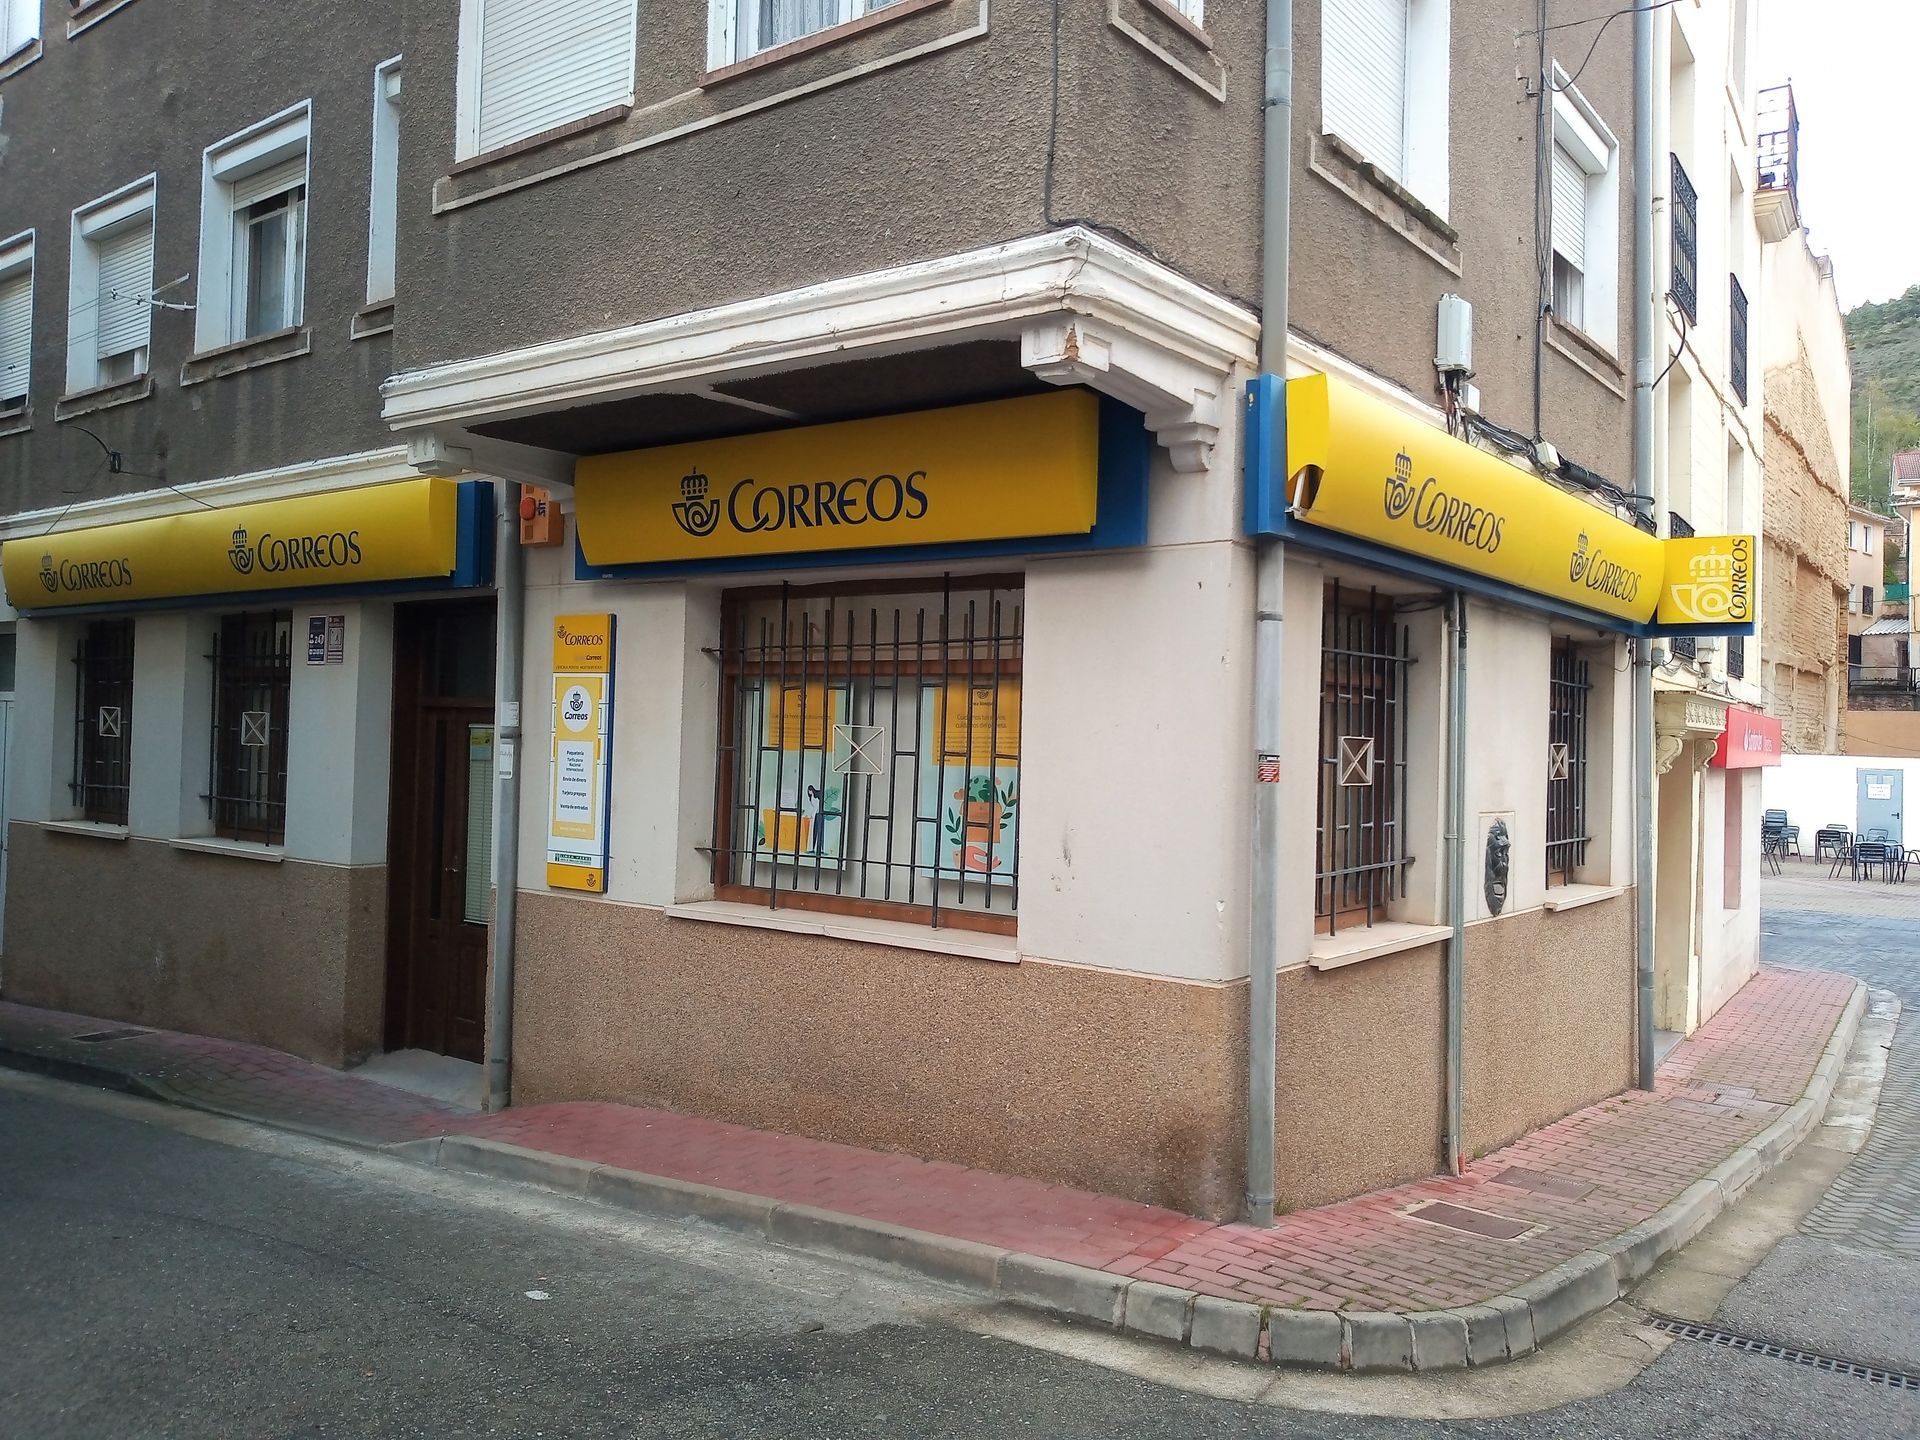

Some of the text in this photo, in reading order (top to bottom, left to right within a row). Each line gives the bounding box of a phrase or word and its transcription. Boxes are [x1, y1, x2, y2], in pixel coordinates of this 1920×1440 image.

[727, 470, 928, 533] CORREOS
[1413, 477, 1505, 553] CORREOS
[60, 558, 132, 591] CORREOS
[257, 530, 361, 572] CORREOS
[1585, 549, 1641, 603] CORREOS
[1728, 538, 1748, 619] CORREOS
[564, 633, 603, 646] CORREOS
[564, 711, 588, 721] Correos
